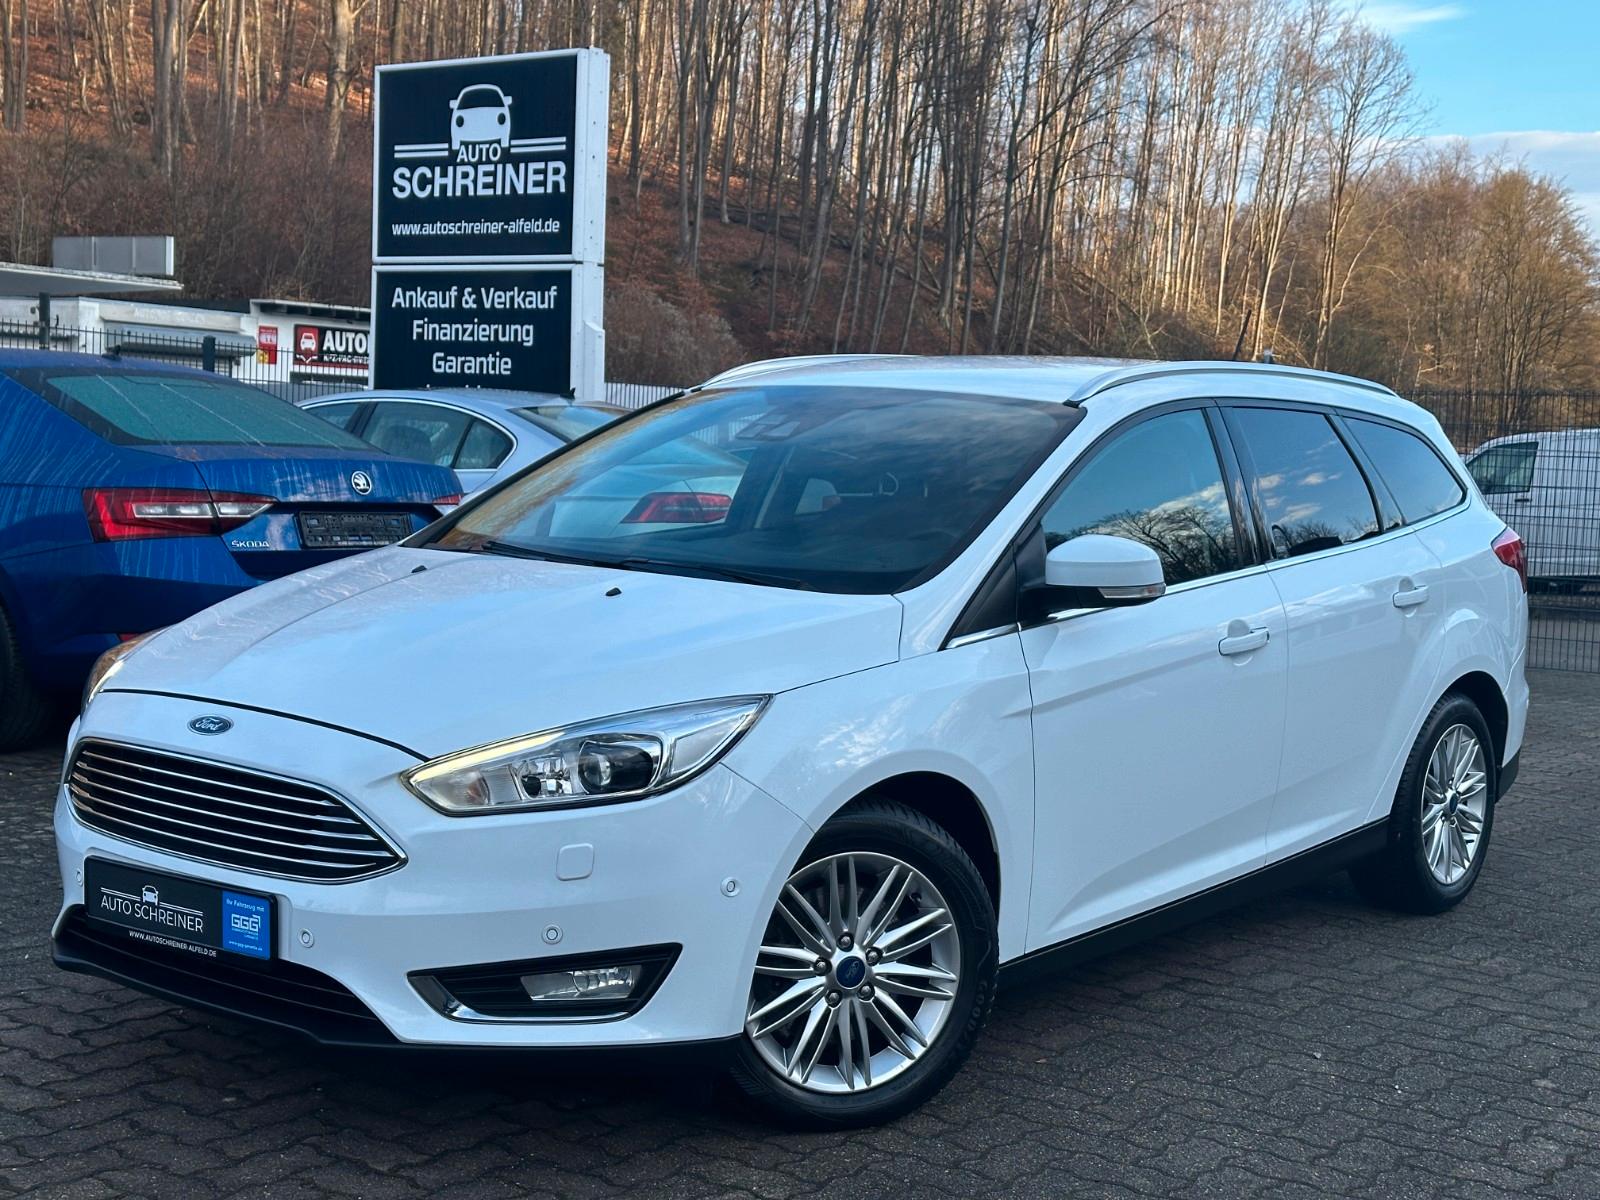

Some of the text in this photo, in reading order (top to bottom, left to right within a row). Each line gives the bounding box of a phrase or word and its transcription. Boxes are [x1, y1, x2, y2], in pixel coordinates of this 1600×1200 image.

[456, 143, 501, 163] AUTO
[391, 160, 567, 199] SCHREINER
[391, 217, 560, 236] www.autoschreiner-alfeld.de
[391, 285, 558, 309] Ankauf & Verkauf
[412, 317, 534, 346] Finanzierung
[432, 351, 512, 375] Garantie
[100, 894, 204, 933] AUTO SCHREINER
[129, 929, 217, 958] WWW.AUTOSCHREINER-ALFELD.DE
